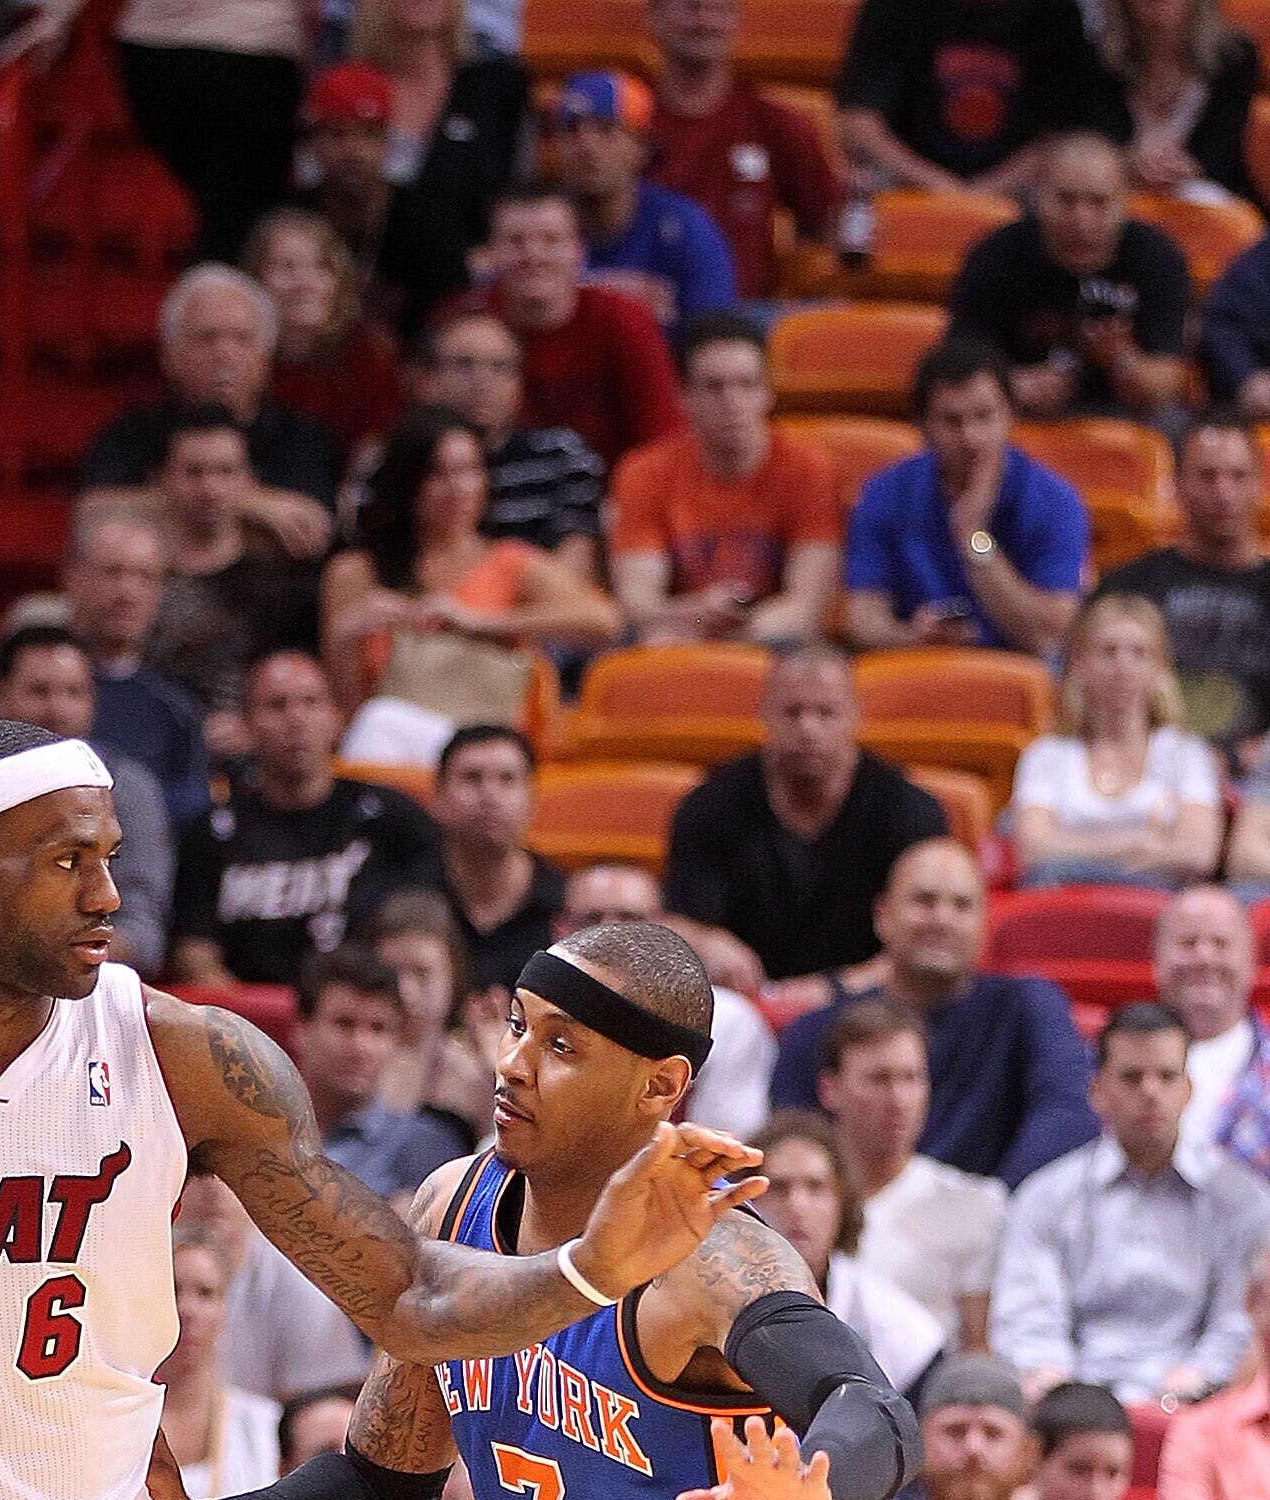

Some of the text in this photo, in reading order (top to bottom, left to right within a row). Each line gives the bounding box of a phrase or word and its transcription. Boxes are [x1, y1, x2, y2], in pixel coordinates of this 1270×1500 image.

[16, 1272, 87, 1382] 6
[434, 1356, 494, 1416] EW
[514, 1342, 654, 1478] YORK
